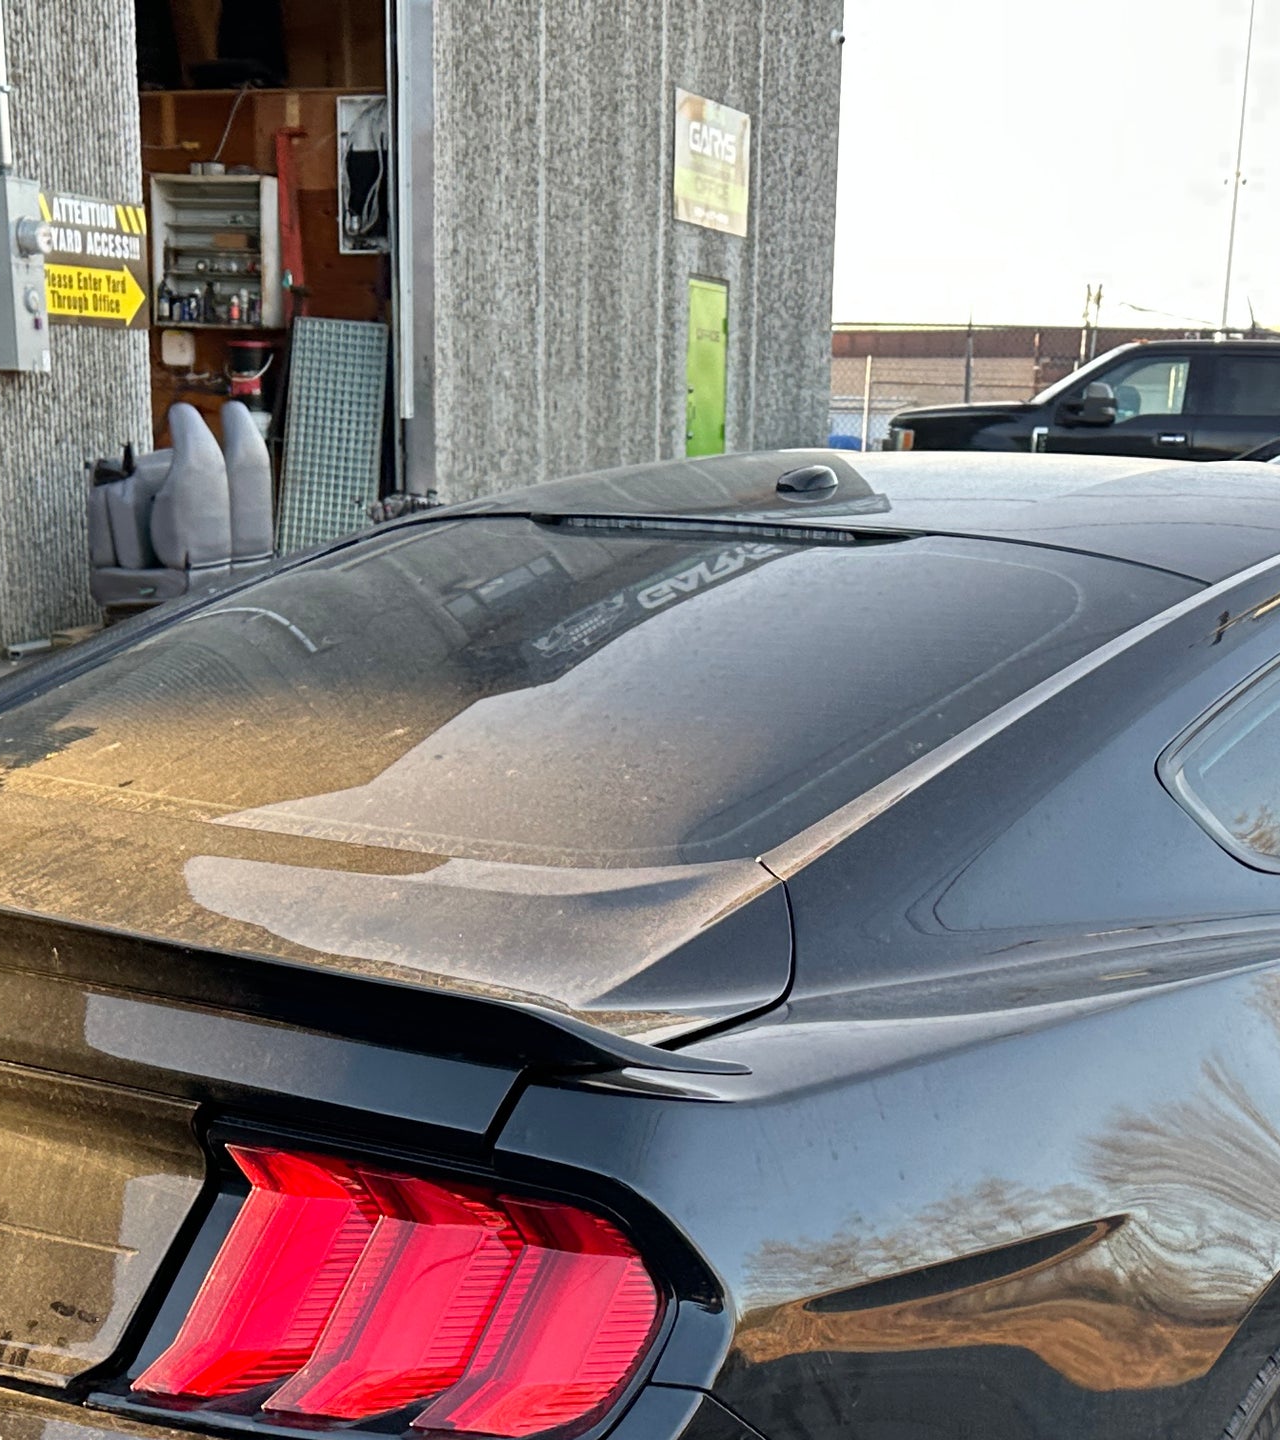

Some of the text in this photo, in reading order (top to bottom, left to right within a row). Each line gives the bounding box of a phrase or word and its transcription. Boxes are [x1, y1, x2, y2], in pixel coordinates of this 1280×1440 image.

[689, 121, 737, 165] GARYS
[52, 197, 117, 229] ATTENTION
[50, 226, 140, 260] YARD ACCESS!!!
[77, 271, 102, 292] Enter
[105, 274, 127, 294] Yard
[50, 290, 121, 314] Through Office
